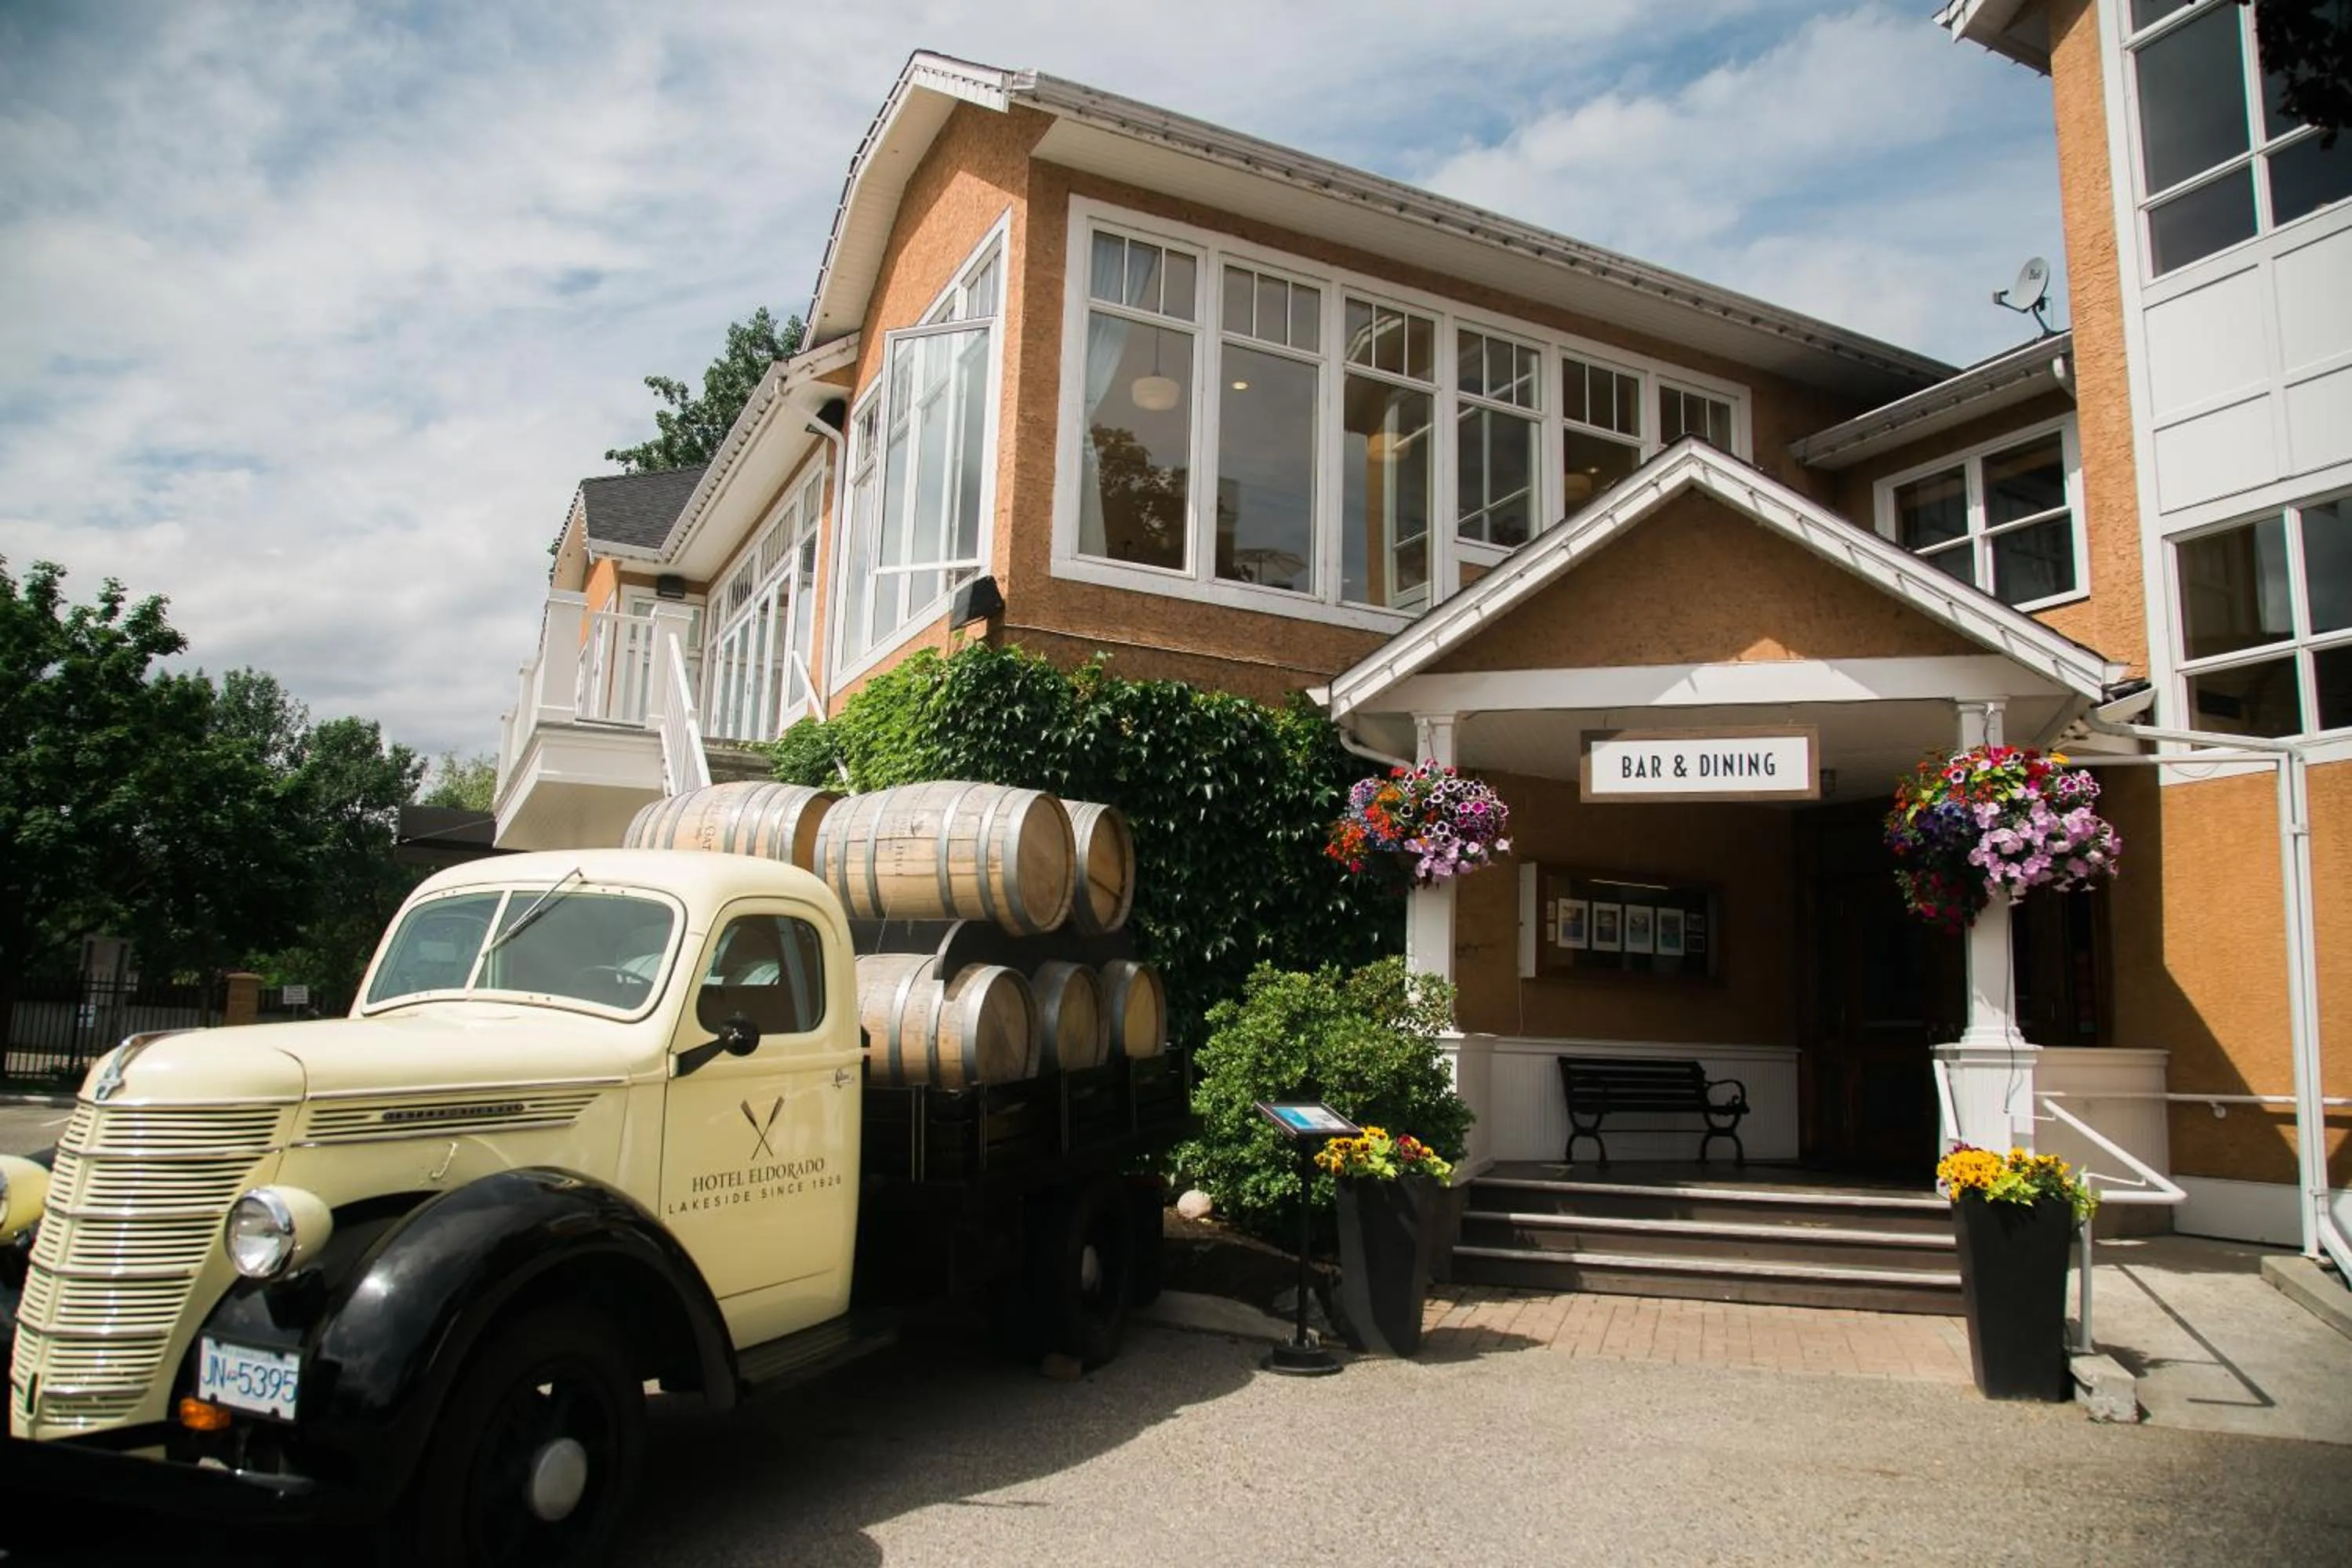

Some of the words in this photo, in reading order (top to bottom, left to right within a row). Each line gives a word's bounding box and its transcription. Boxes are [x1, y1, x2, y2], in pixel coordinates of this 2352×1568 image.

[1621, 754, 1662, 779] BAR
[1673, 754, 1687, 778] &
[1699, 752, 1777, 777] DINING
[691, 1171, 745, 1192] HOTEL
[749, 1157, 825, 1185] ELDORADO
[668, 1191, 751, 1214] LAKESIDE
[760, 1181, 804, 1200] SINCE
